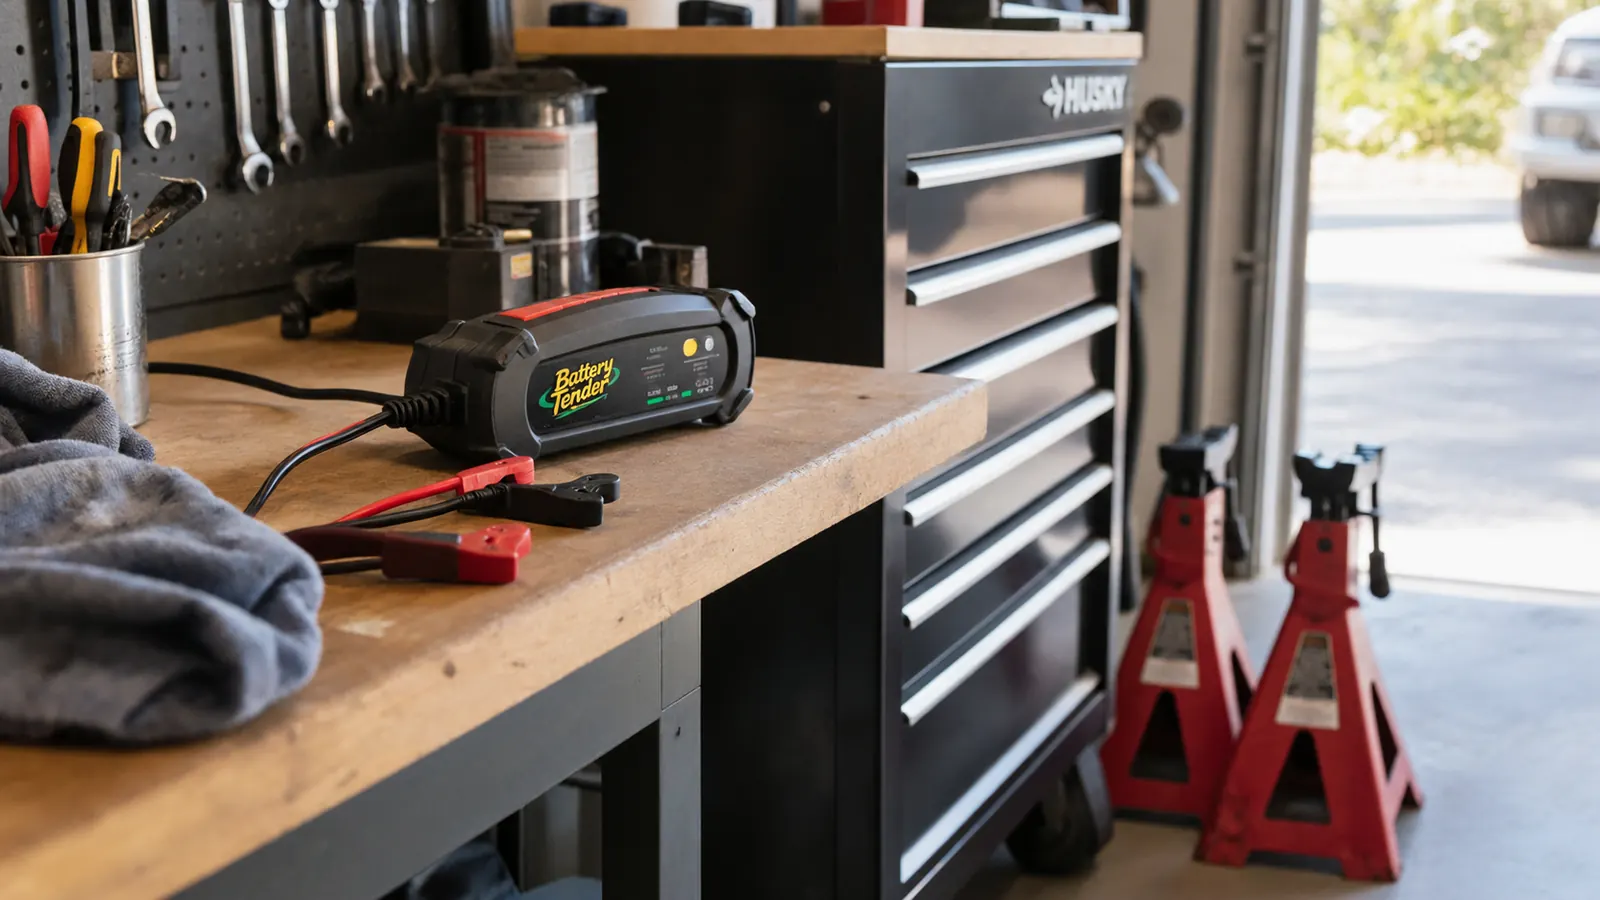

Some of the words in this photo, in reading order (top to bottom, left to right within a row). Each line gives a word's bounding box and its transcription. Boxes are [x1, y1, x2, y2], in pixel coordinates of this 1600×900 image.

[1064, 75, 1127, 115] HUSKY
[554, 358, 614, 392] Battery
[551, 378, 610, 416] Tender
